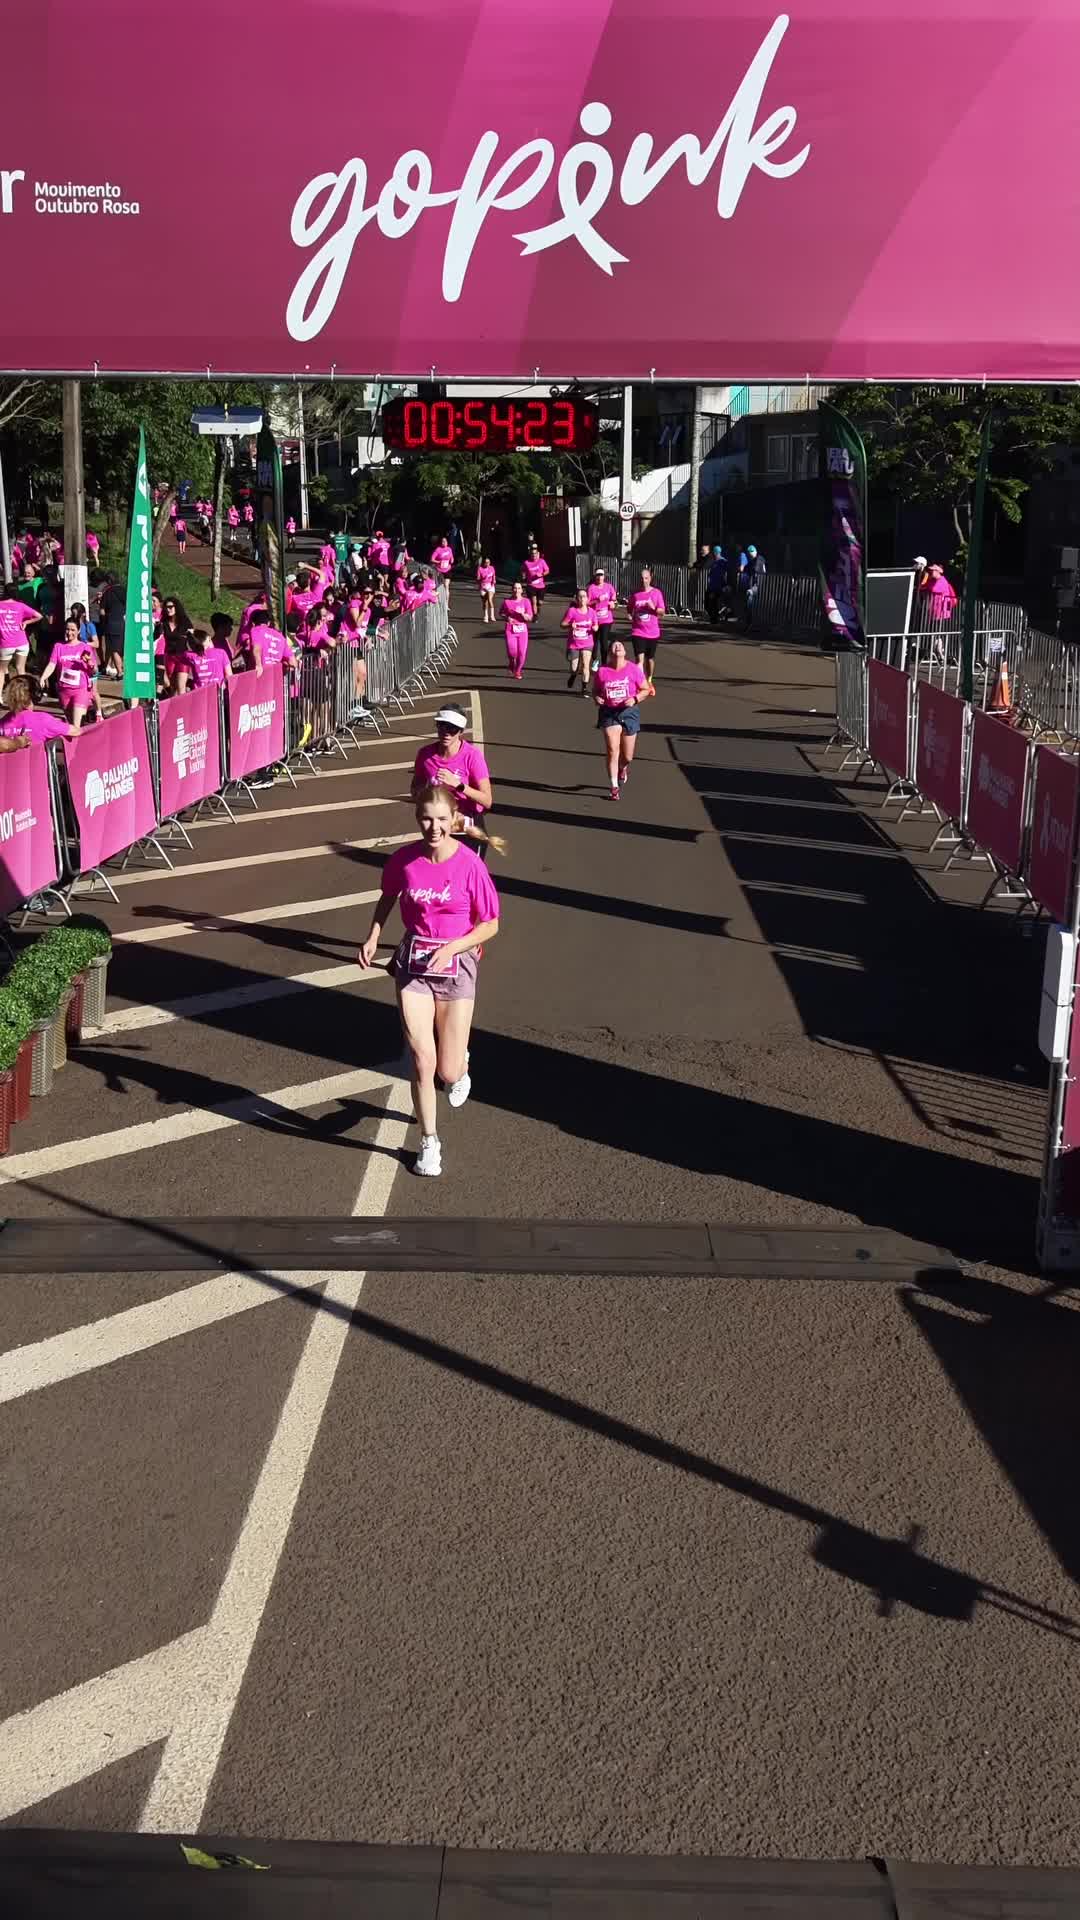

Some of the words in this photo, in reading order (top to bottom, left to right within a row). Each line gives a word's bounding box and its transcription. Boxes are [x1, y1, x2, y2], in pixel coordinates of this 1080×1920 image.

[35, 181, 121, 198] Movimento
[286, 14, 811, 342] gopink
[35, 198, 98, 213] Outubro
[103, 199, 140, 214] Rosa
[404, 402, 575, 445] 00:54:23
[622, 505, 634, 513] 40
[103, 757, 139, 788] PALHANO
